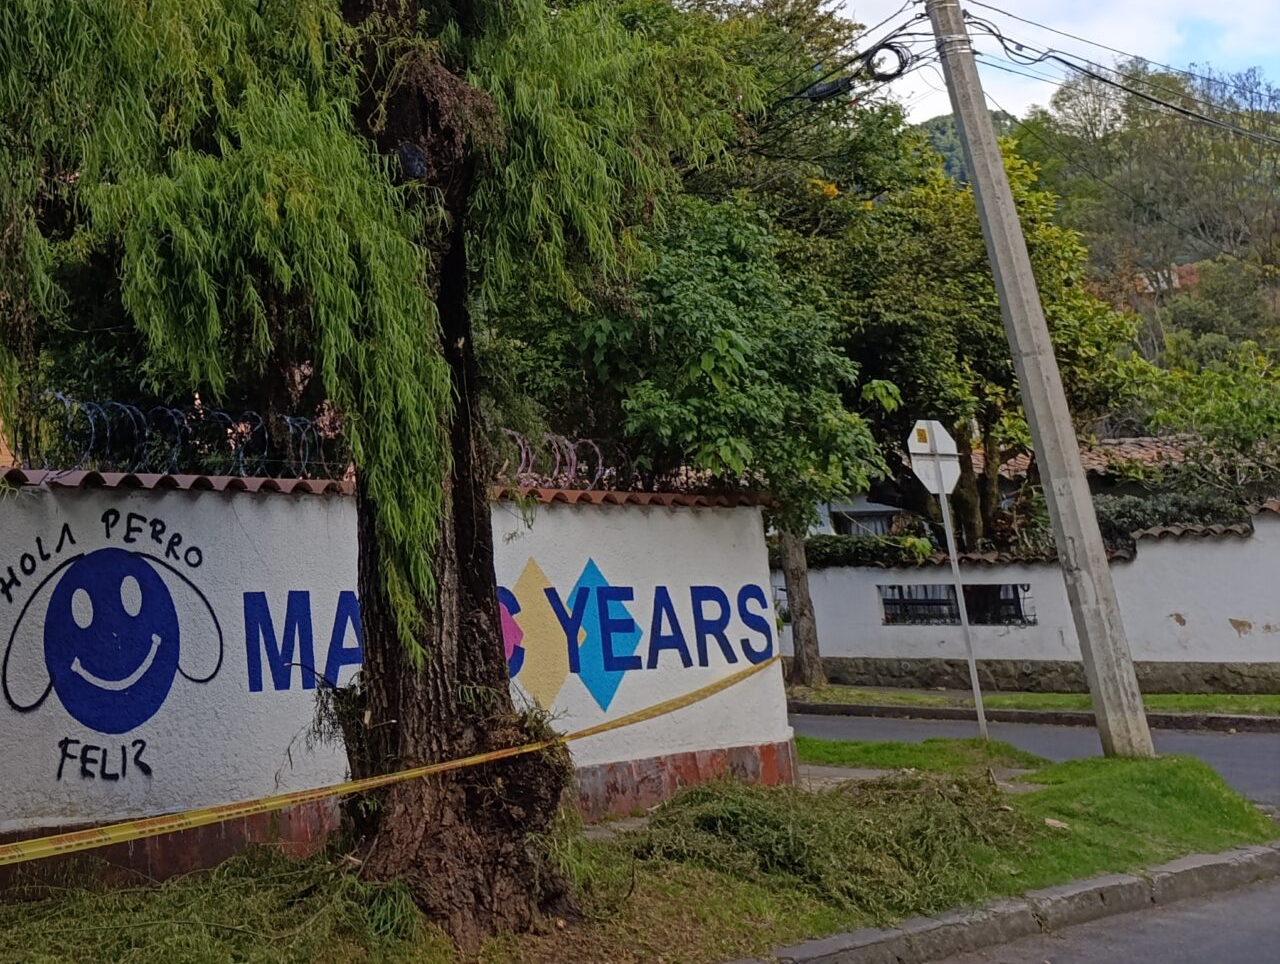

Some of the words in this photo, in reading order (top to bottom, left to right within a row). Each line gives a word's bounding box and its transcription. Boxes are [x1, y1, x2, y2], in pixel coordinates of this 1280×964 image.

[0, 522, 76, 603] HOLA
[100, 507, 204, 569] PERRO
[242, 585, 526, 693] MAC
[543, 583, 774, 674] YEARS
